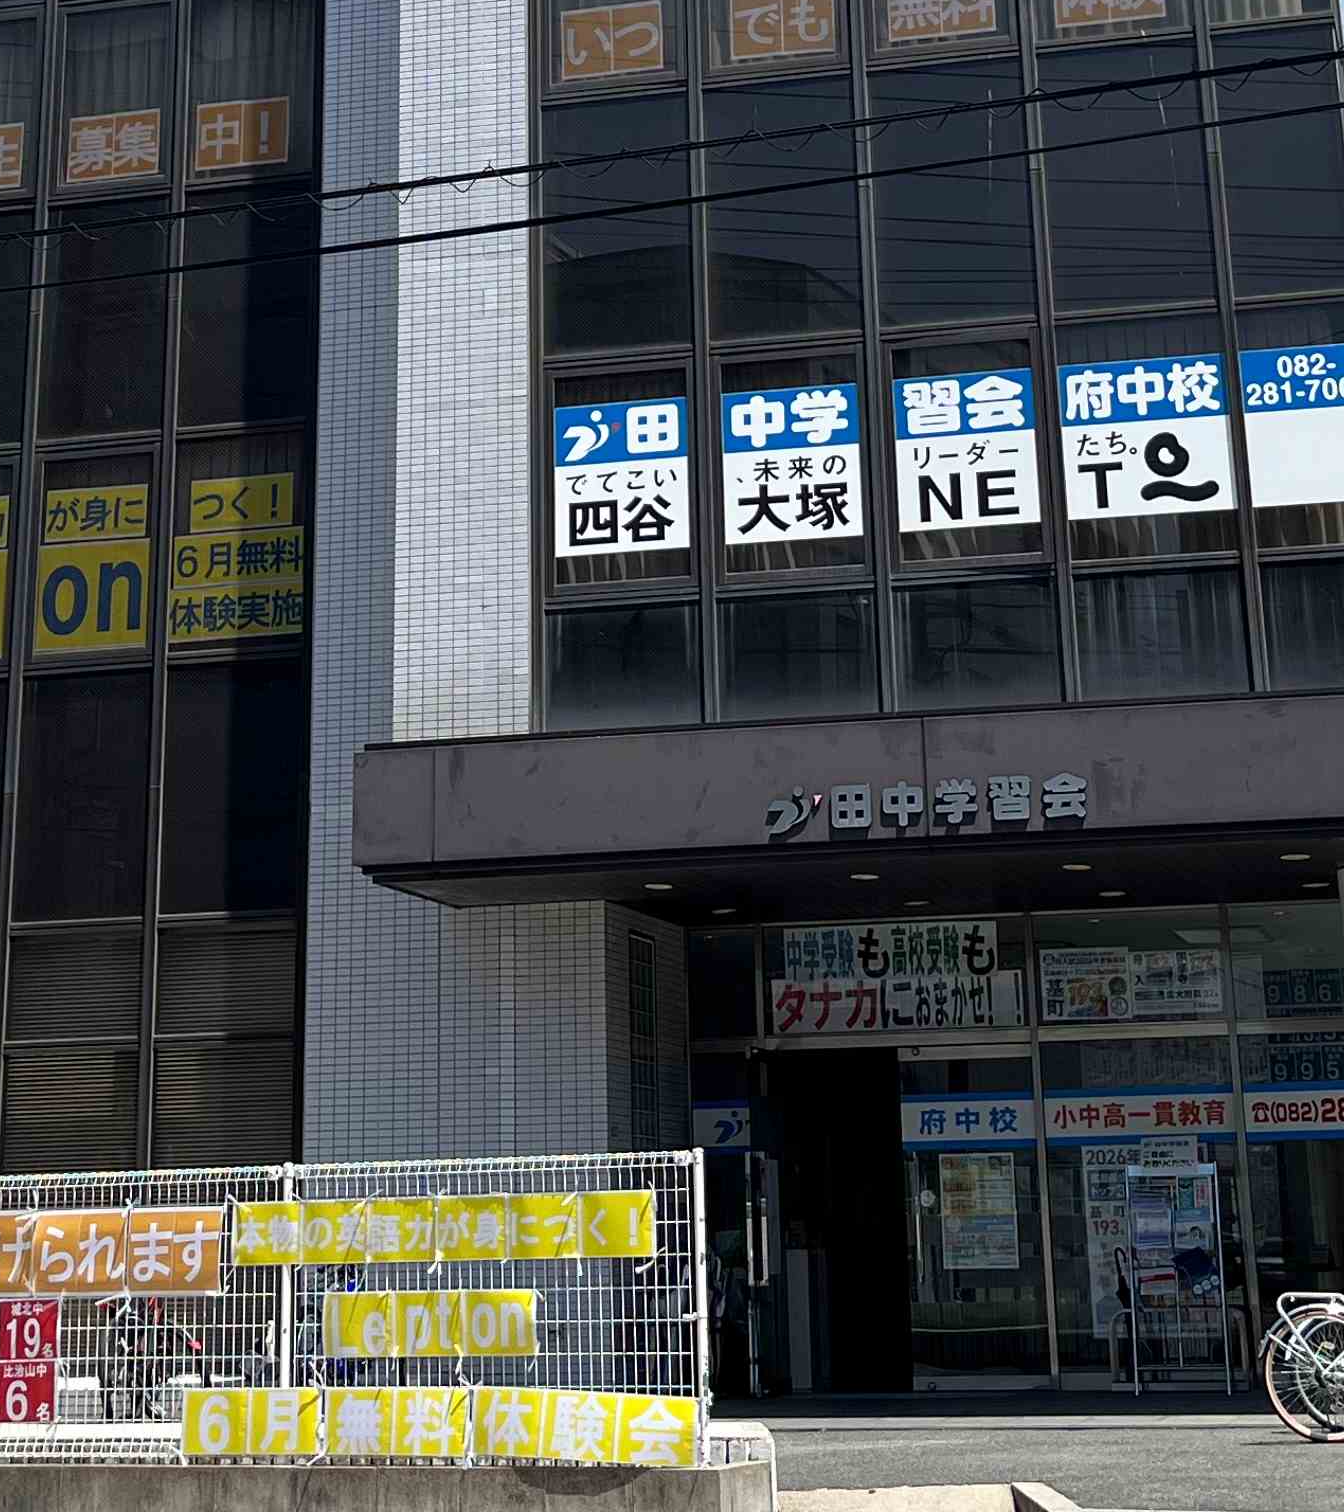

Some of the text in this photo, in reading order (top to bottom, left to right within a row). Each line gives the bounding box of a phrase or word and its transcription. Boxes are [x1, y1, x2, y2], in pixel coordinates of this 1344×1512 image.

[1065, 360, 1223, 423] 府中校
[1276, 352, 1336, 381] 082-
[564, 468, 678, 496] でてこい
[912, 440, 1021, 467] リーダー
[568, 496, 675, 547] 四谷
[736, 484, 850, 536] 大塚
[177, 537, 304, 579] 6月無料
[169, 588, 304, 635] 体験実施
[829, 771, 1089, 830] 田中学習会
[785, 923, 997, 981] 中学受験も高校受験も
[918, 1106, 1019, 1137] 府中校
[1053, 1099, 1228, 1130] 小中高一貫教育
[329, 1298, 527, 1354] Lepton
[196, 1391, 685, 1464] 6月無料体験会
